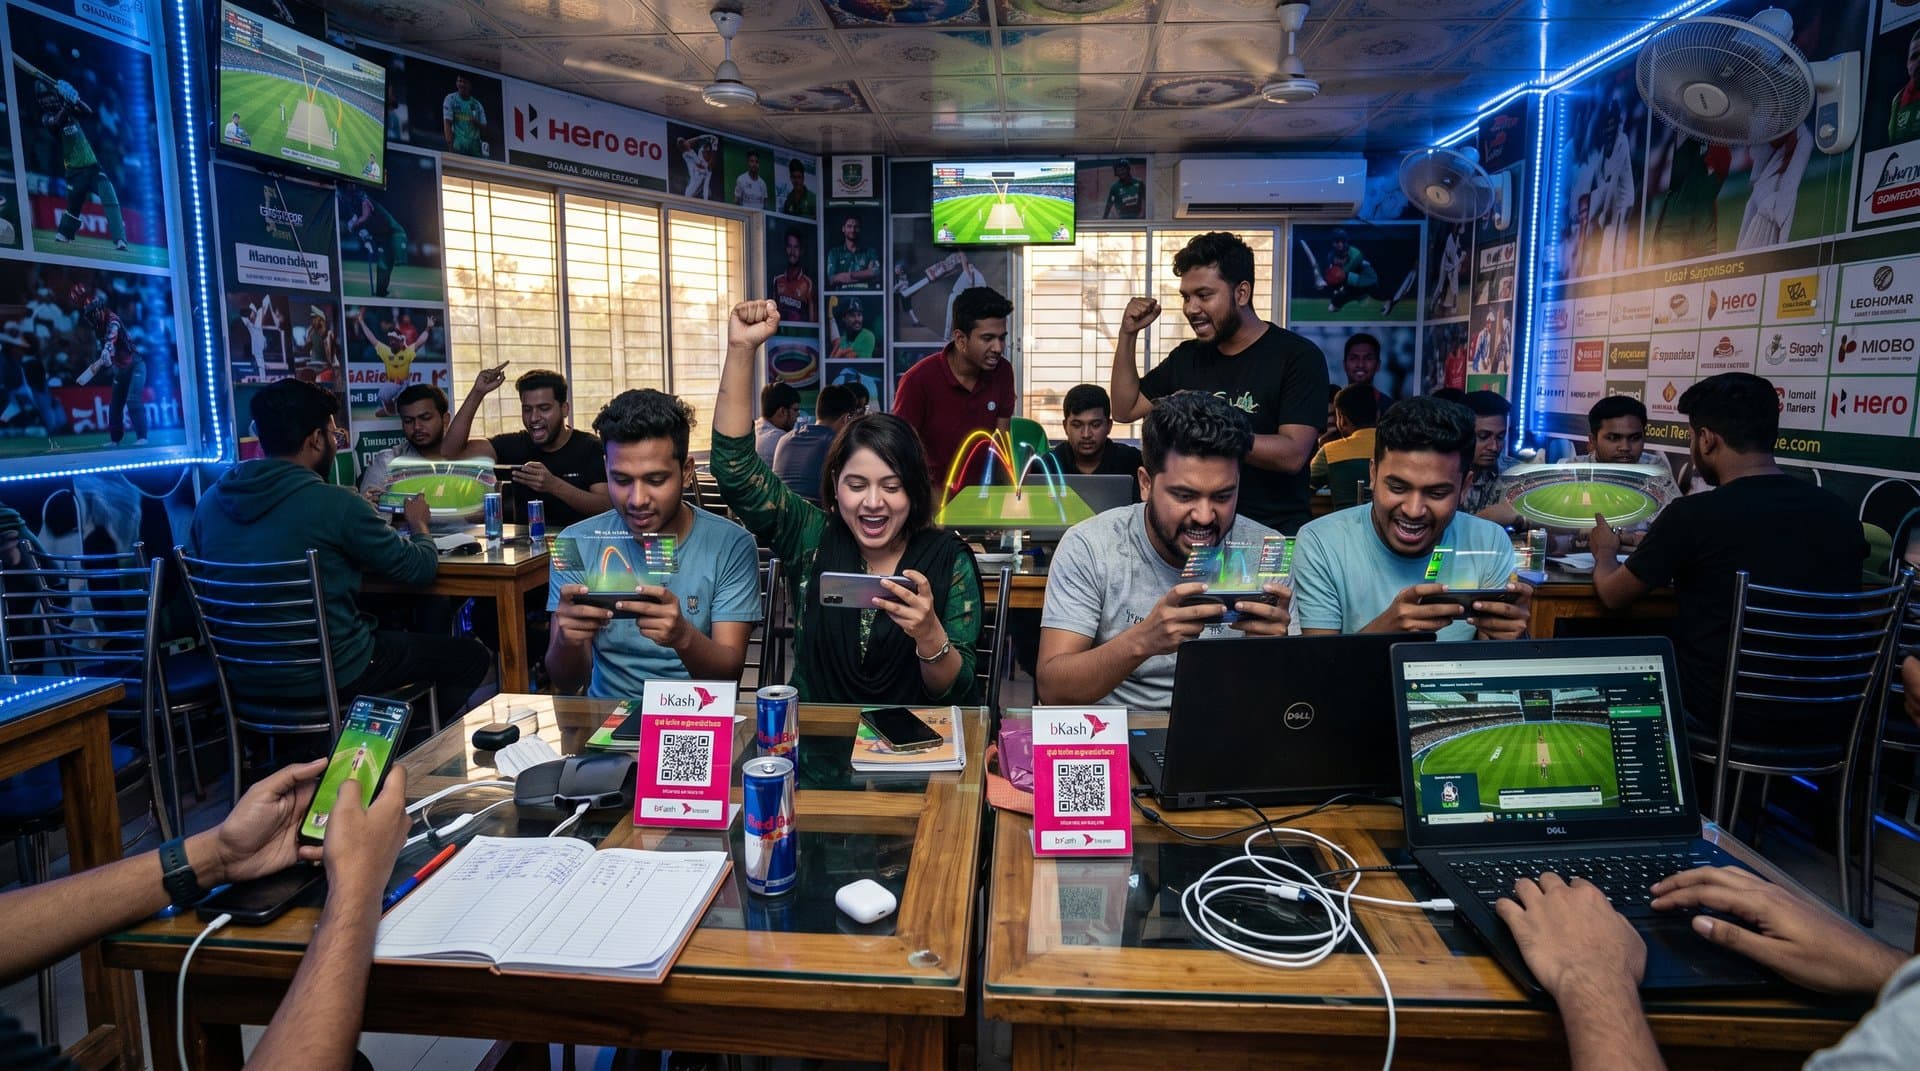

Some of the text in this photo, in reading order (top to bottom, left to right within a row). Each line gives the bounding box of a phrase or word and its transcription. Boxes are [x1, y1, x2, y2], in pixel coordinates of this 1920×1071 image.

[548, 118, 663, 161] Hero ero
[1721, 293, 1758, 311] Hero
[1850, 293, 1914, 309] LEOHOMAR
[1861, 338, 1915, 354] MIOBO
[1853, 394, 1908, 416] Hero
[660, 693, 695, 707] bKash
[1287, 711, 1311, 720] DELL
[1050, 722, 1087, 735] bKash
